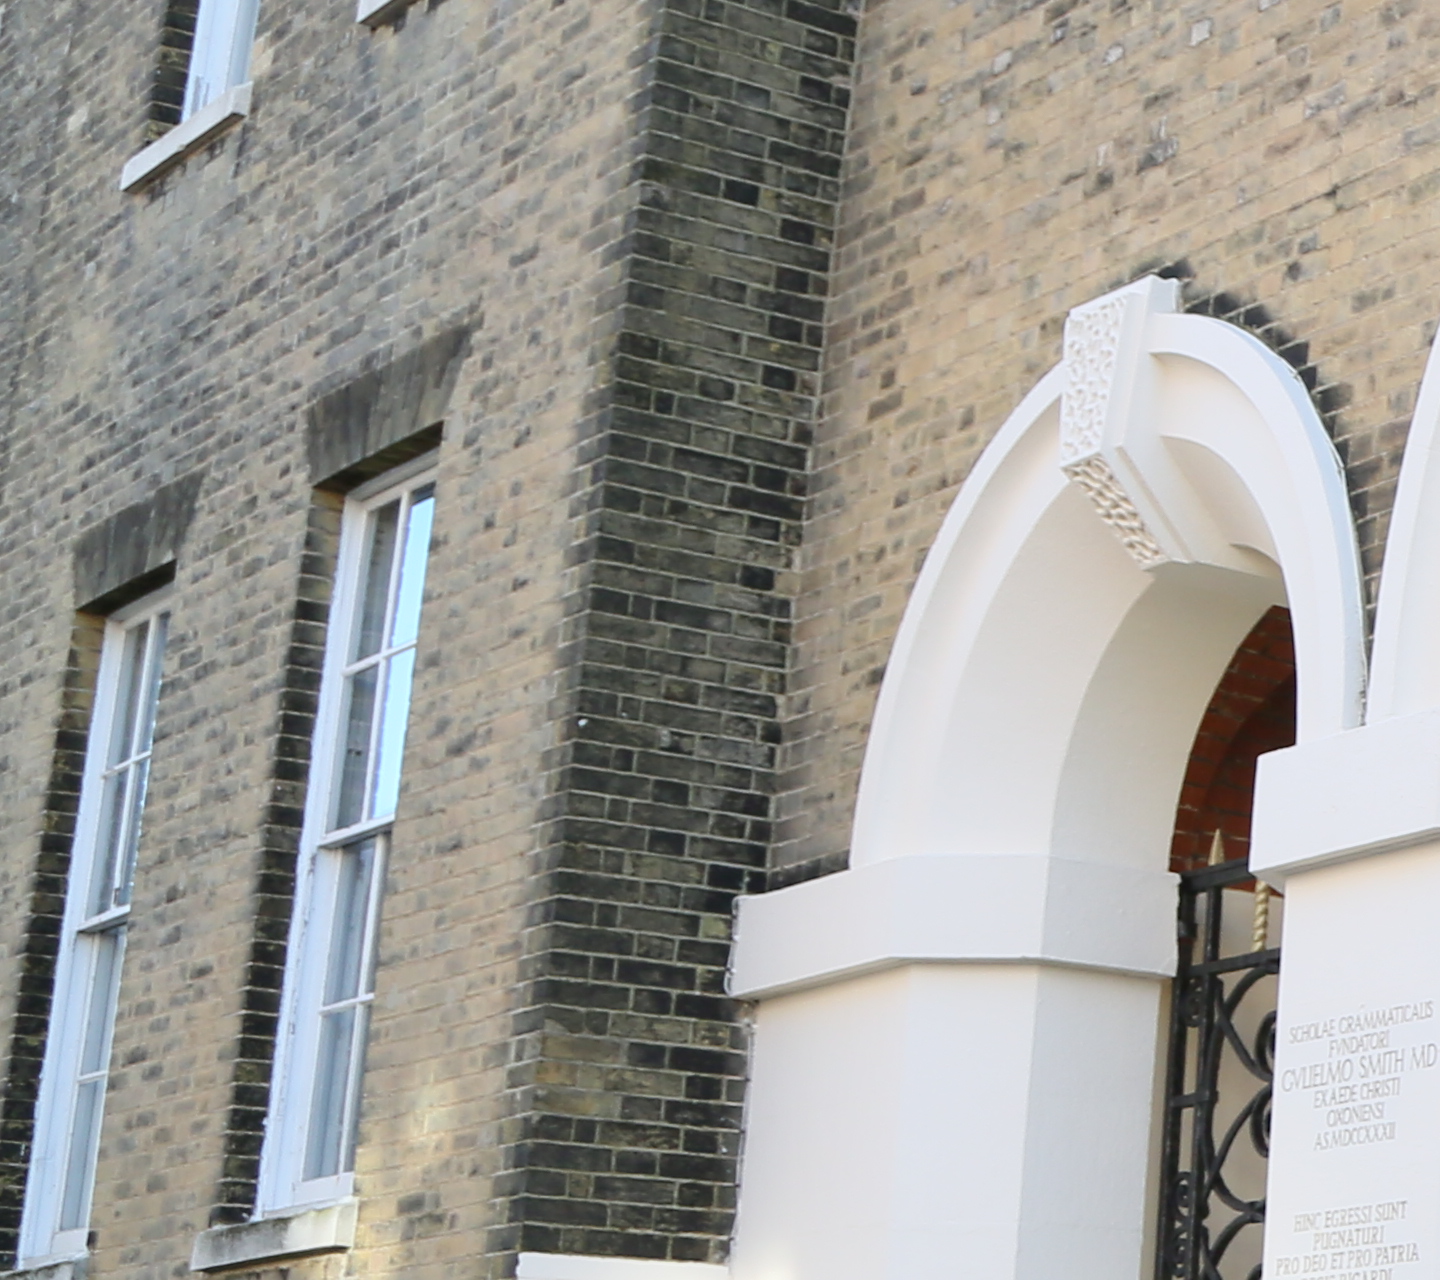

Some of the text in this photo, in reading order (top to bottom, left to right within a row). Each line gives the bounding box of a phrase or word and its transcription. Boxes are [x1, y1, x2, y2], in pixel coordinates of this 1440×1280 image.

[1289, 1000, 1434, 1044] SCHOLAE GRAMMATICALIS
[1329, 1030, 1390, 1058] FVNDATORI
[1282, 1043, 1438, 1092] GVLIELMO SMITH MD
[1360, 1077, 1401, 1100] CHRISTI
[1294, 1200, 1408, 1232] HINC EGRESSI SUNT
[1313, 1226, 1385, 1251] PUGNATURI
[1276, 1243, 1420, 1276] PRO DEO ET PRO PATRIA
